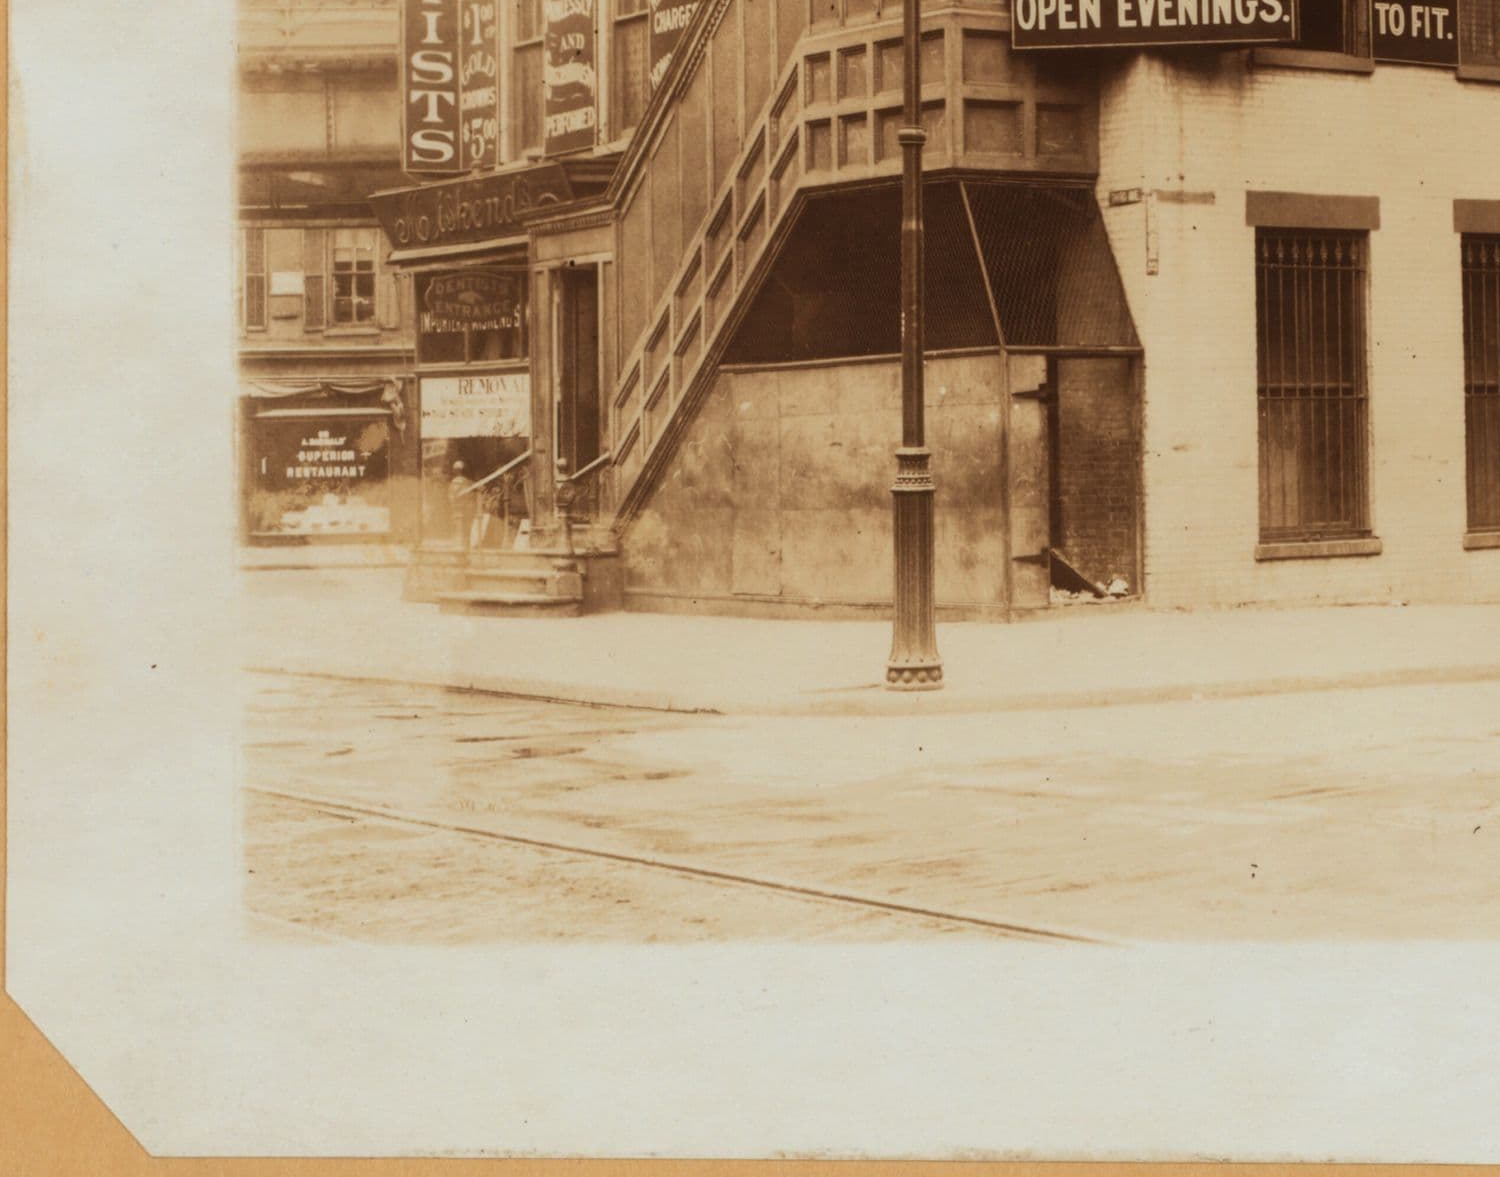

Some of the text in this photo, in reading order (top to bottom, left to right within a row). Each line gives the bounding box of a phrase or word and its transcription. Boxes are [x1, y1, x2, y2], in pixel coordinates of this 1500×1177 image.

[1374, 1, 1454, 40] TO FIT.
[559, 32, 585, 53] AND
[461, 50, 497, 87] GOLD
[297, 449, 356, 463] SUPERIOR
[285, 465, 367, 479] RESTAURANT
